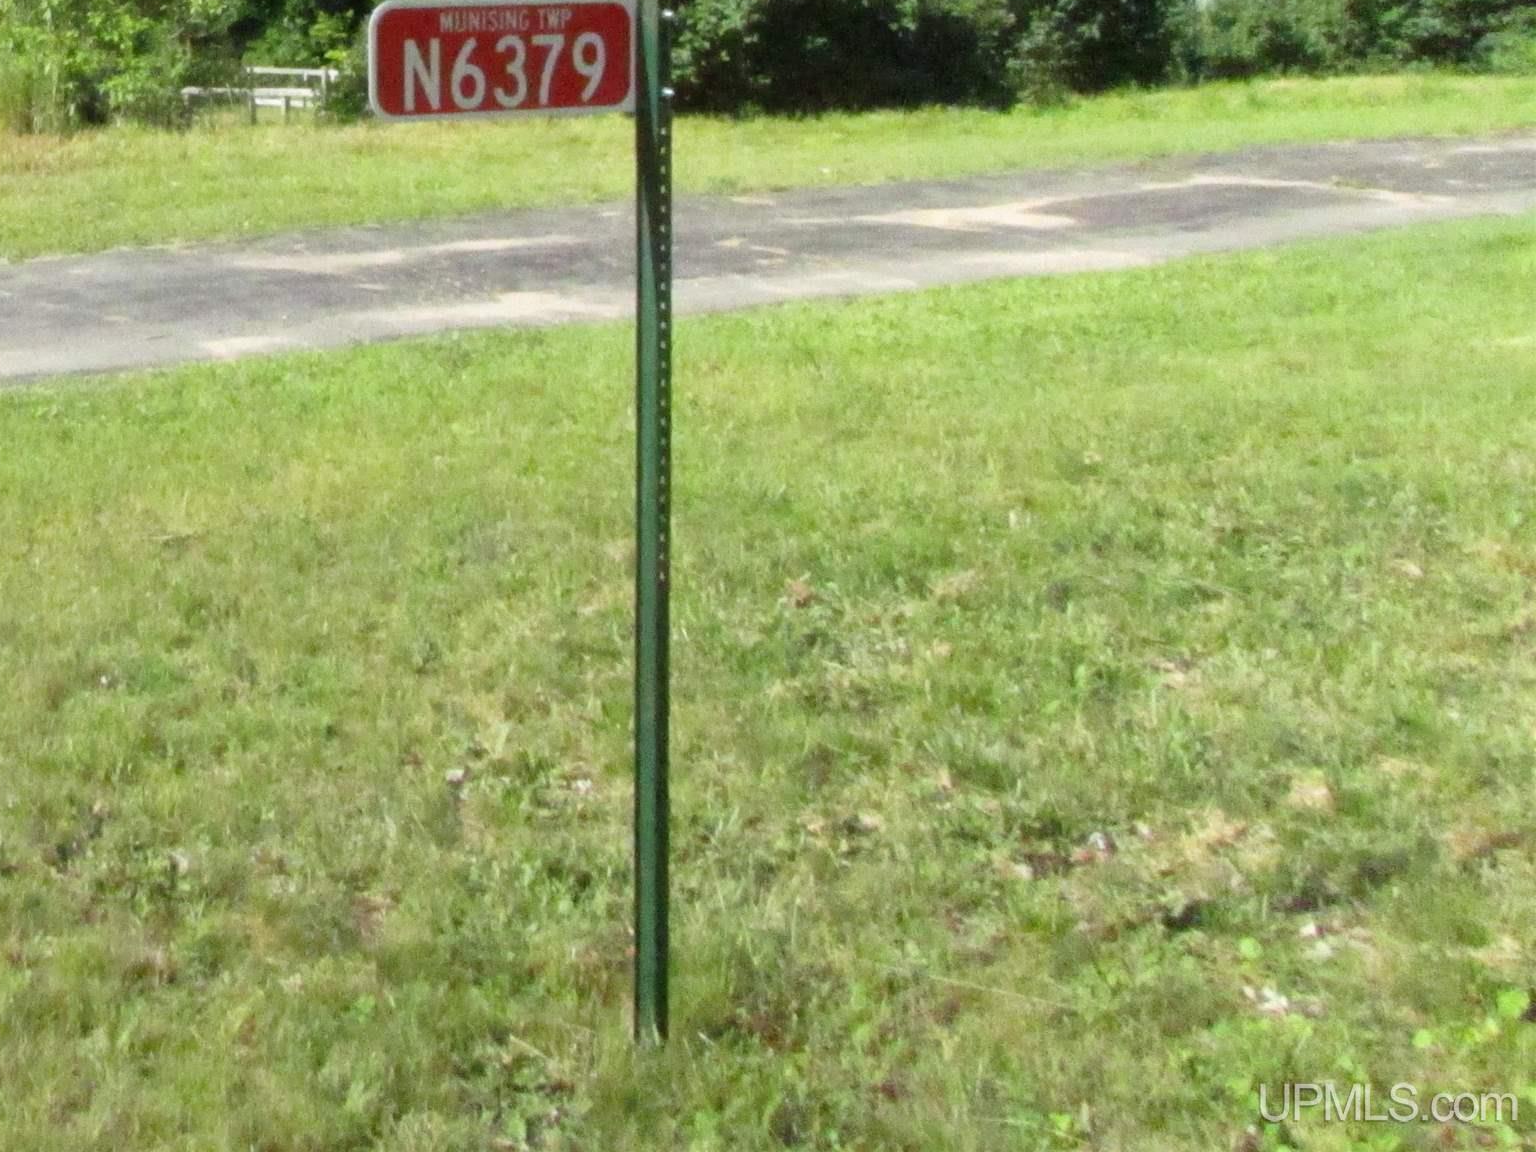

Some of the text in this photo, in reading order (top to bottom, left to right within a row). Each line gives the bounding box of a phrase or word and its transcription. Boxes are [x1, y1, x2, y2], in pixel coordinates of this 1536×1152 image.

[440, 8, 572, 33] MUNISING TWP
[404, 32, 606, 112] N6379
